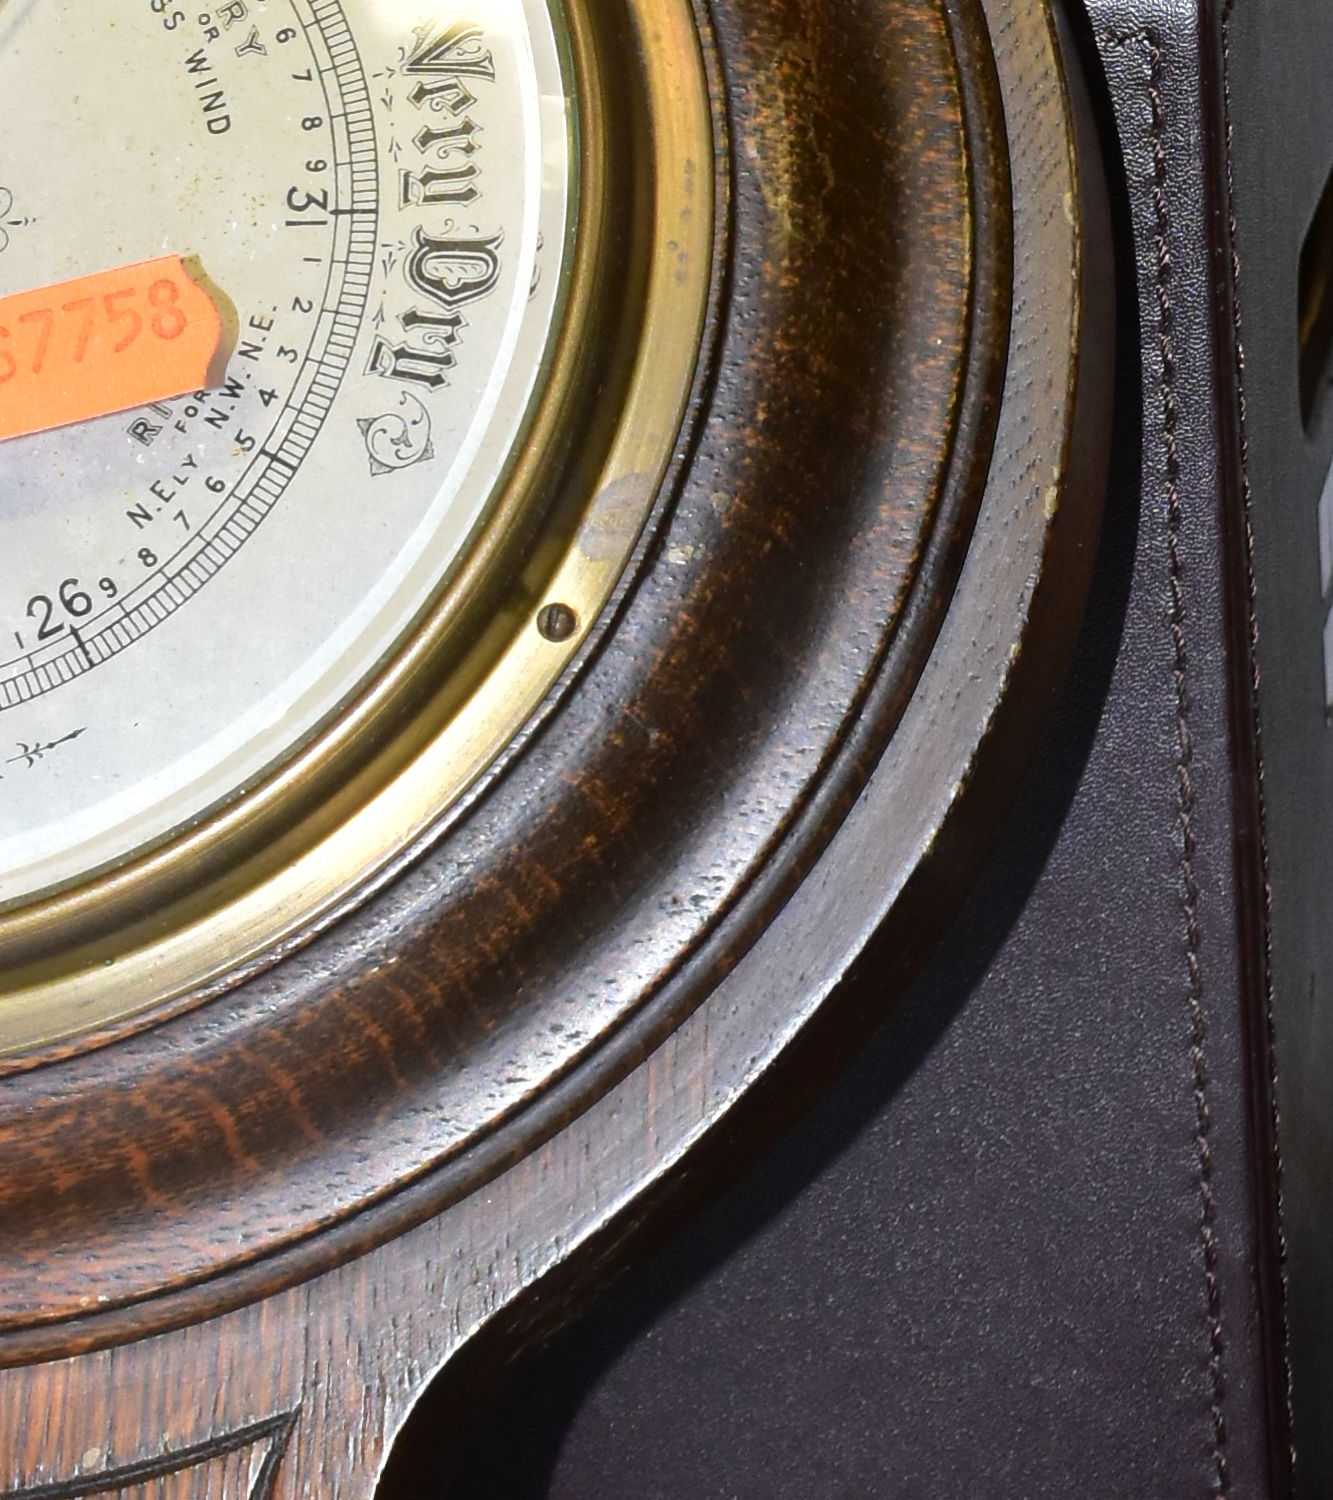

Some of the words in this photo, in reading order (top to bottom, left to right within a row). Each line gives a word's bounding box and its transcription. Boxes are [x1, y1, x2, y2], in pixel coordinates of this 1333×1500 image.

[198, 12, 220, 44] OR
[275, 27, 296, 44] 6
[291, 68, 313, 83] 7
[185, 48, 232, 136] WIND
[301, 115, 323, 131] 8
[305, 158, 328, 173] 9
[284, 185, 329, 228] 31
[292, 296, 314, 313] 2
[277, 345, 298, 364] 3
[258, 388, 279, 408] 4
[174, 390, 211, 434] FOR
[234, 428, 256, 452] 5
[204, 475, 226, 494] 6
[173, 509, 190, 530] 7
[137, 547, 158, 567] 8
[98, 577, 118, 599] 9
[25, 577, 93, 641] 26
